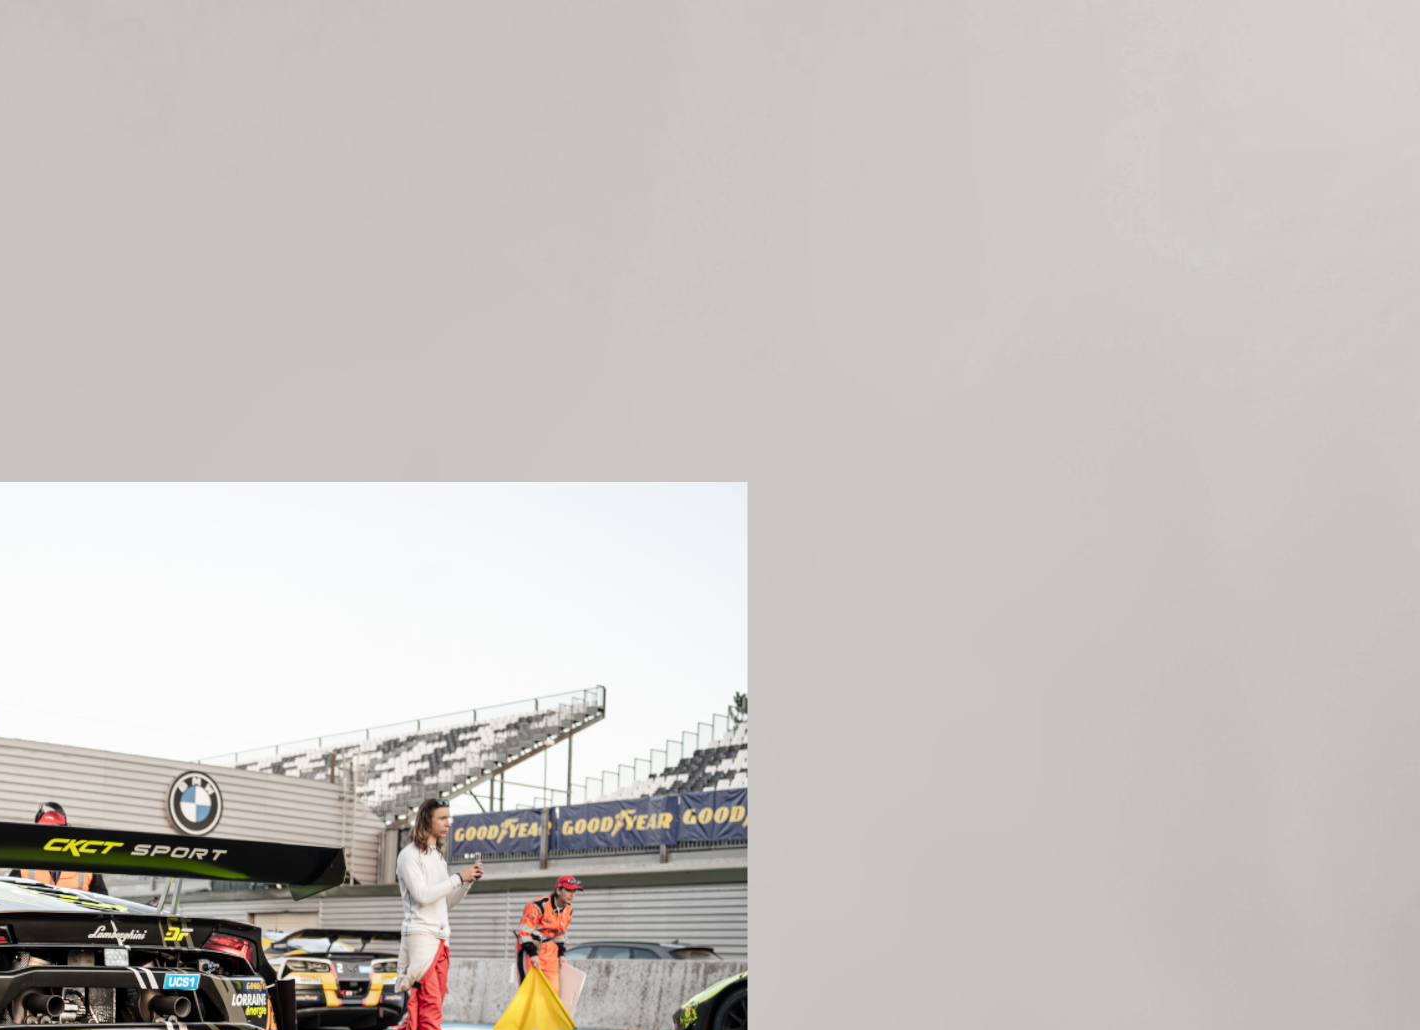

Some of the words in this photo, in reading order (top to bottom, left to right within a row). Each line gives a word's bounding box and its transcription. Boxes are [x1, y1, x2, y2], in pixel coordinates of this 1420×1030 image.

[177, 777, 215, 796] BMW
[561, 809, 674, 837] GOODYEAR
[43, 838, 125, 857] CKCT
[130, 844, 228, 861] SPORT
[87, 925, 147, 943] Lamborghini
[168, 977, 195, 988] UCS1
[231, 993, 267, 1006] LORRAINE
